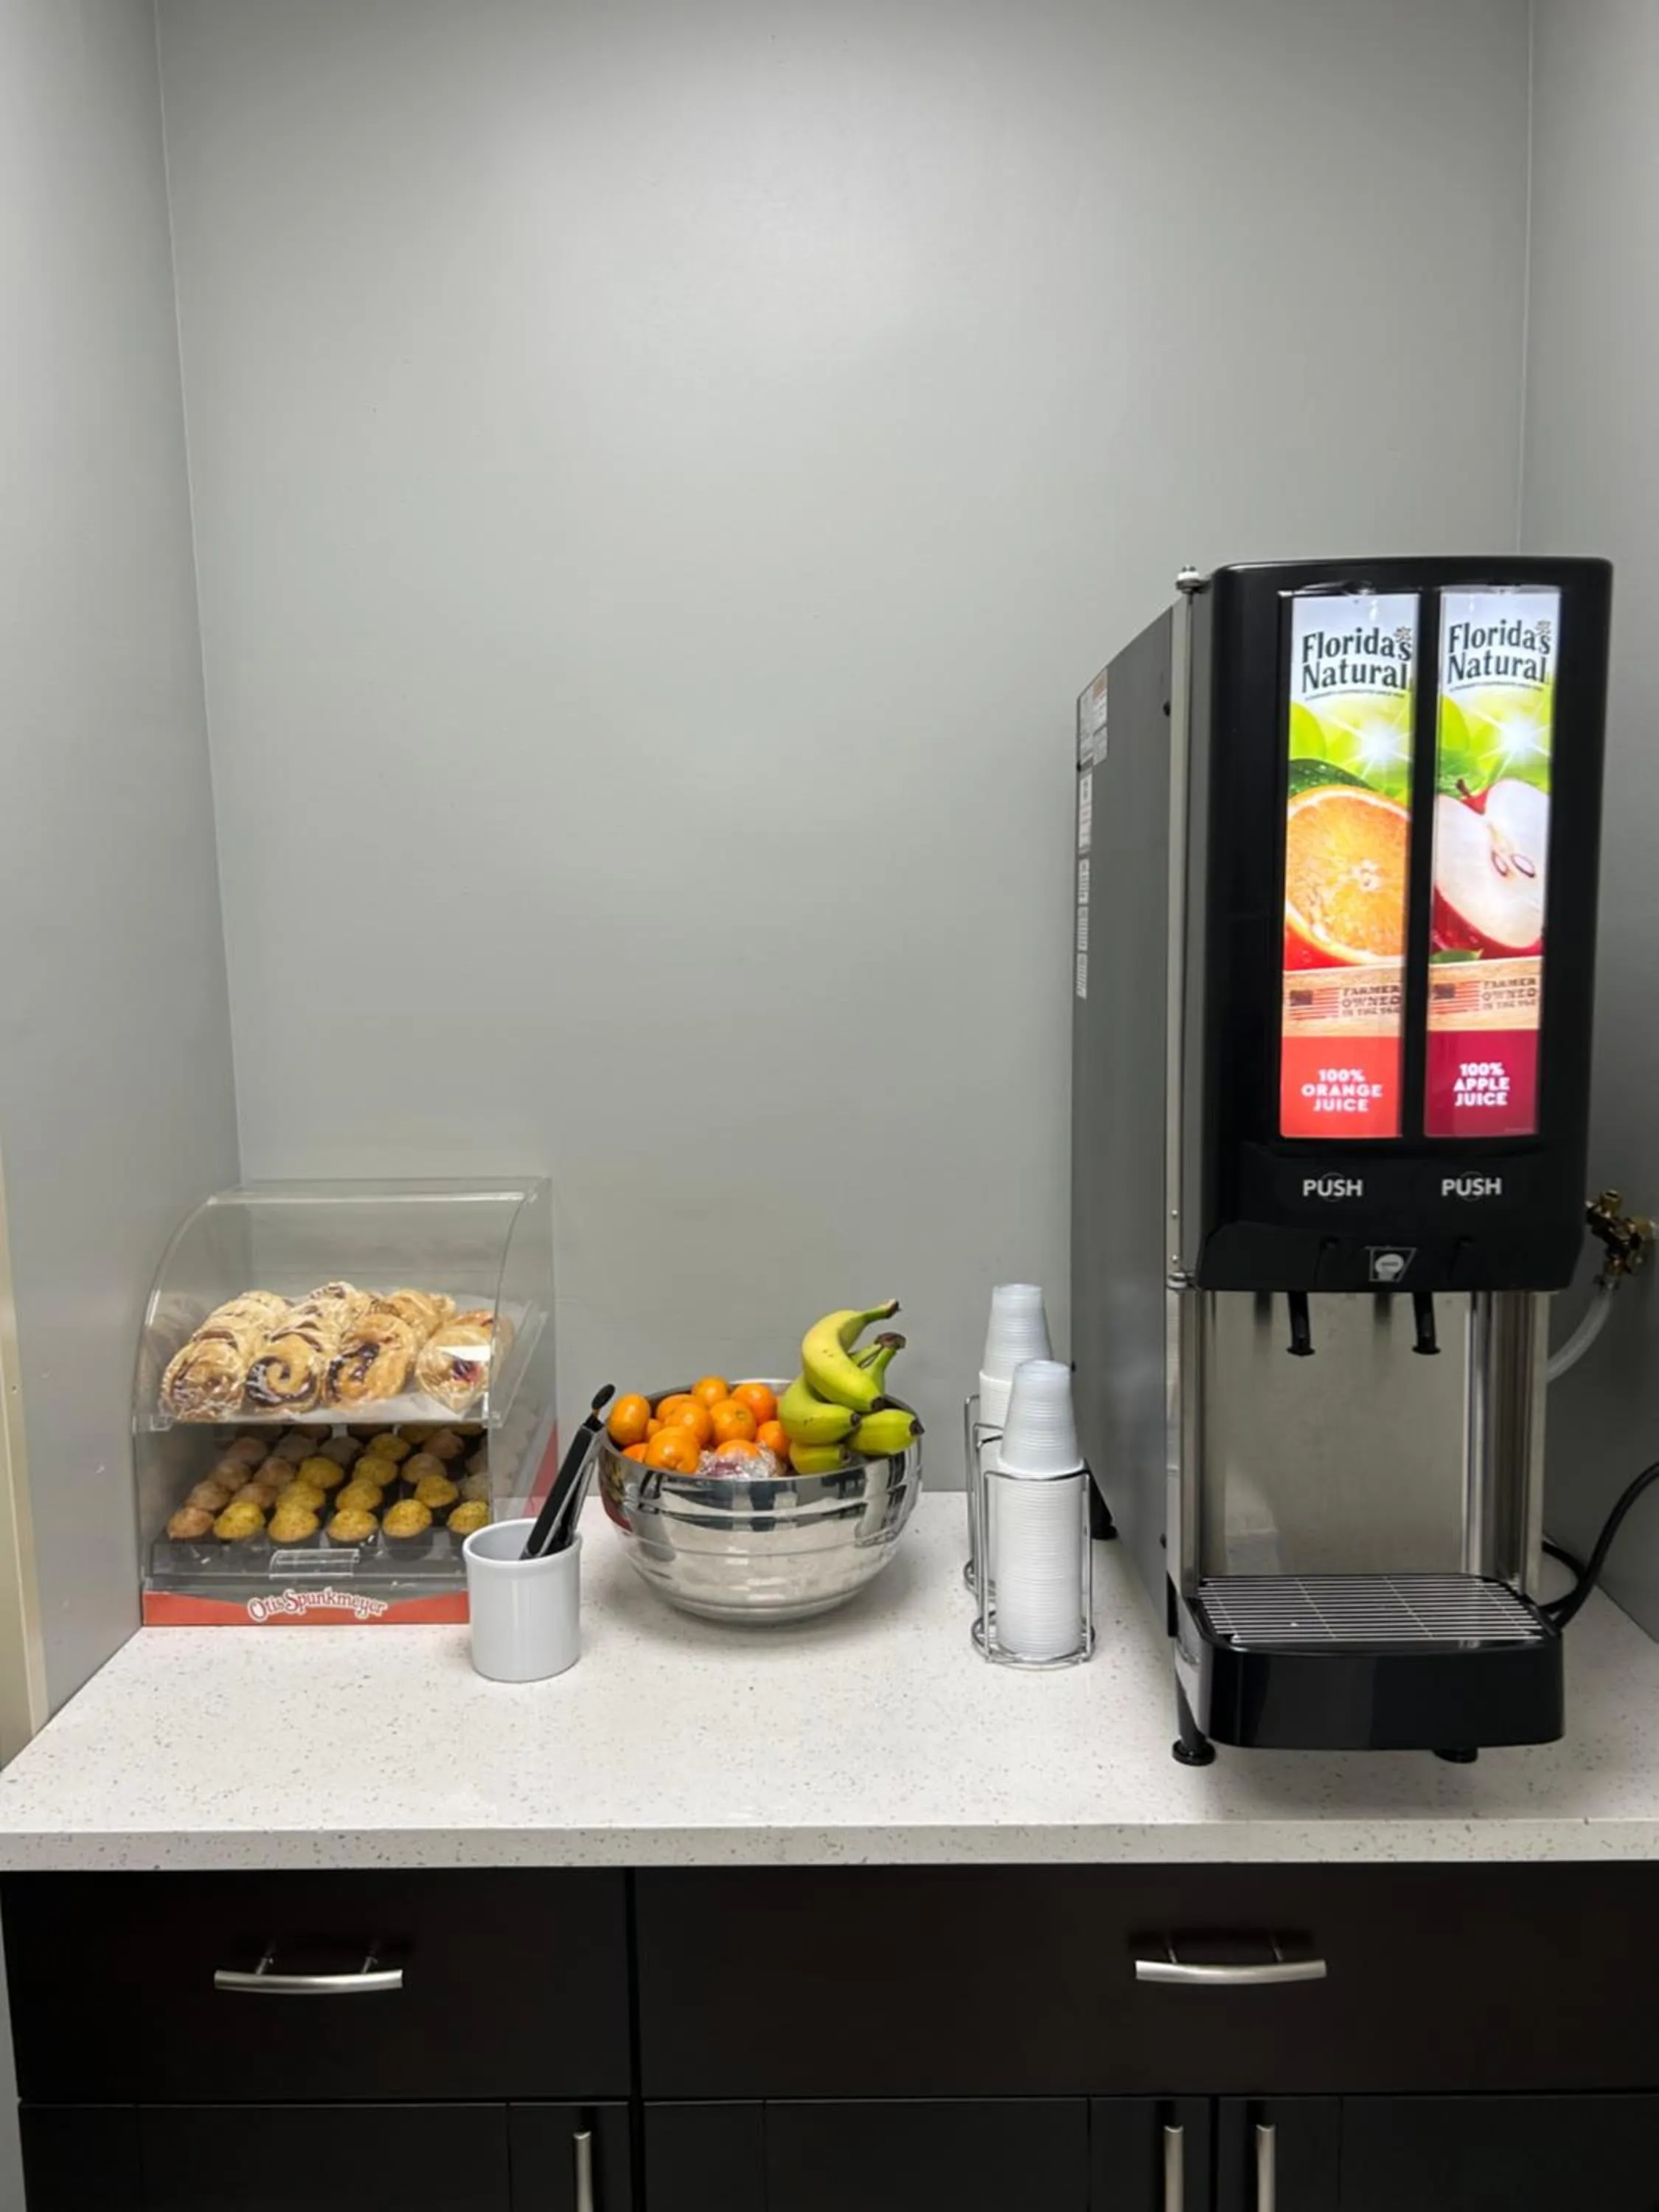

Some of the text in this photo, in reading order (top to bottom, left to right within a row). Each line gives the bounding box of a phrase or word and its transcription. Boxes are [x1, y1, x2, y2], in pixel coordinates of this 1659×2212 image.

[1447, 649, 1547, 684] Natural
[1302, 658, 1408, 693] Natural
[1343, 984, 1399, 996] FARMER
[1484, 978, 1536, 990] FARMER
[1482, 987, 1537, 1001] OWNED
[1342, 995, 1402, 1009] OWNED
[1318, 1068, 1366, 1082] 100%
[1459, 1062, 1506, 1077] 100%
[1301, 1083, 1382, 1098] ORANGE
[1453, 1077, 1510, 1091] APPLE
[1313, 1098, 1368, 1113] JUICE
[1455, 1092, 1508, 1107] JUICE
[1303, 1178, 1363, 1197] PUSH
[1441, 1178, 1502, 1196] PUSH
[248, 1587, 387, 1621] Otis Spunkmeyer
